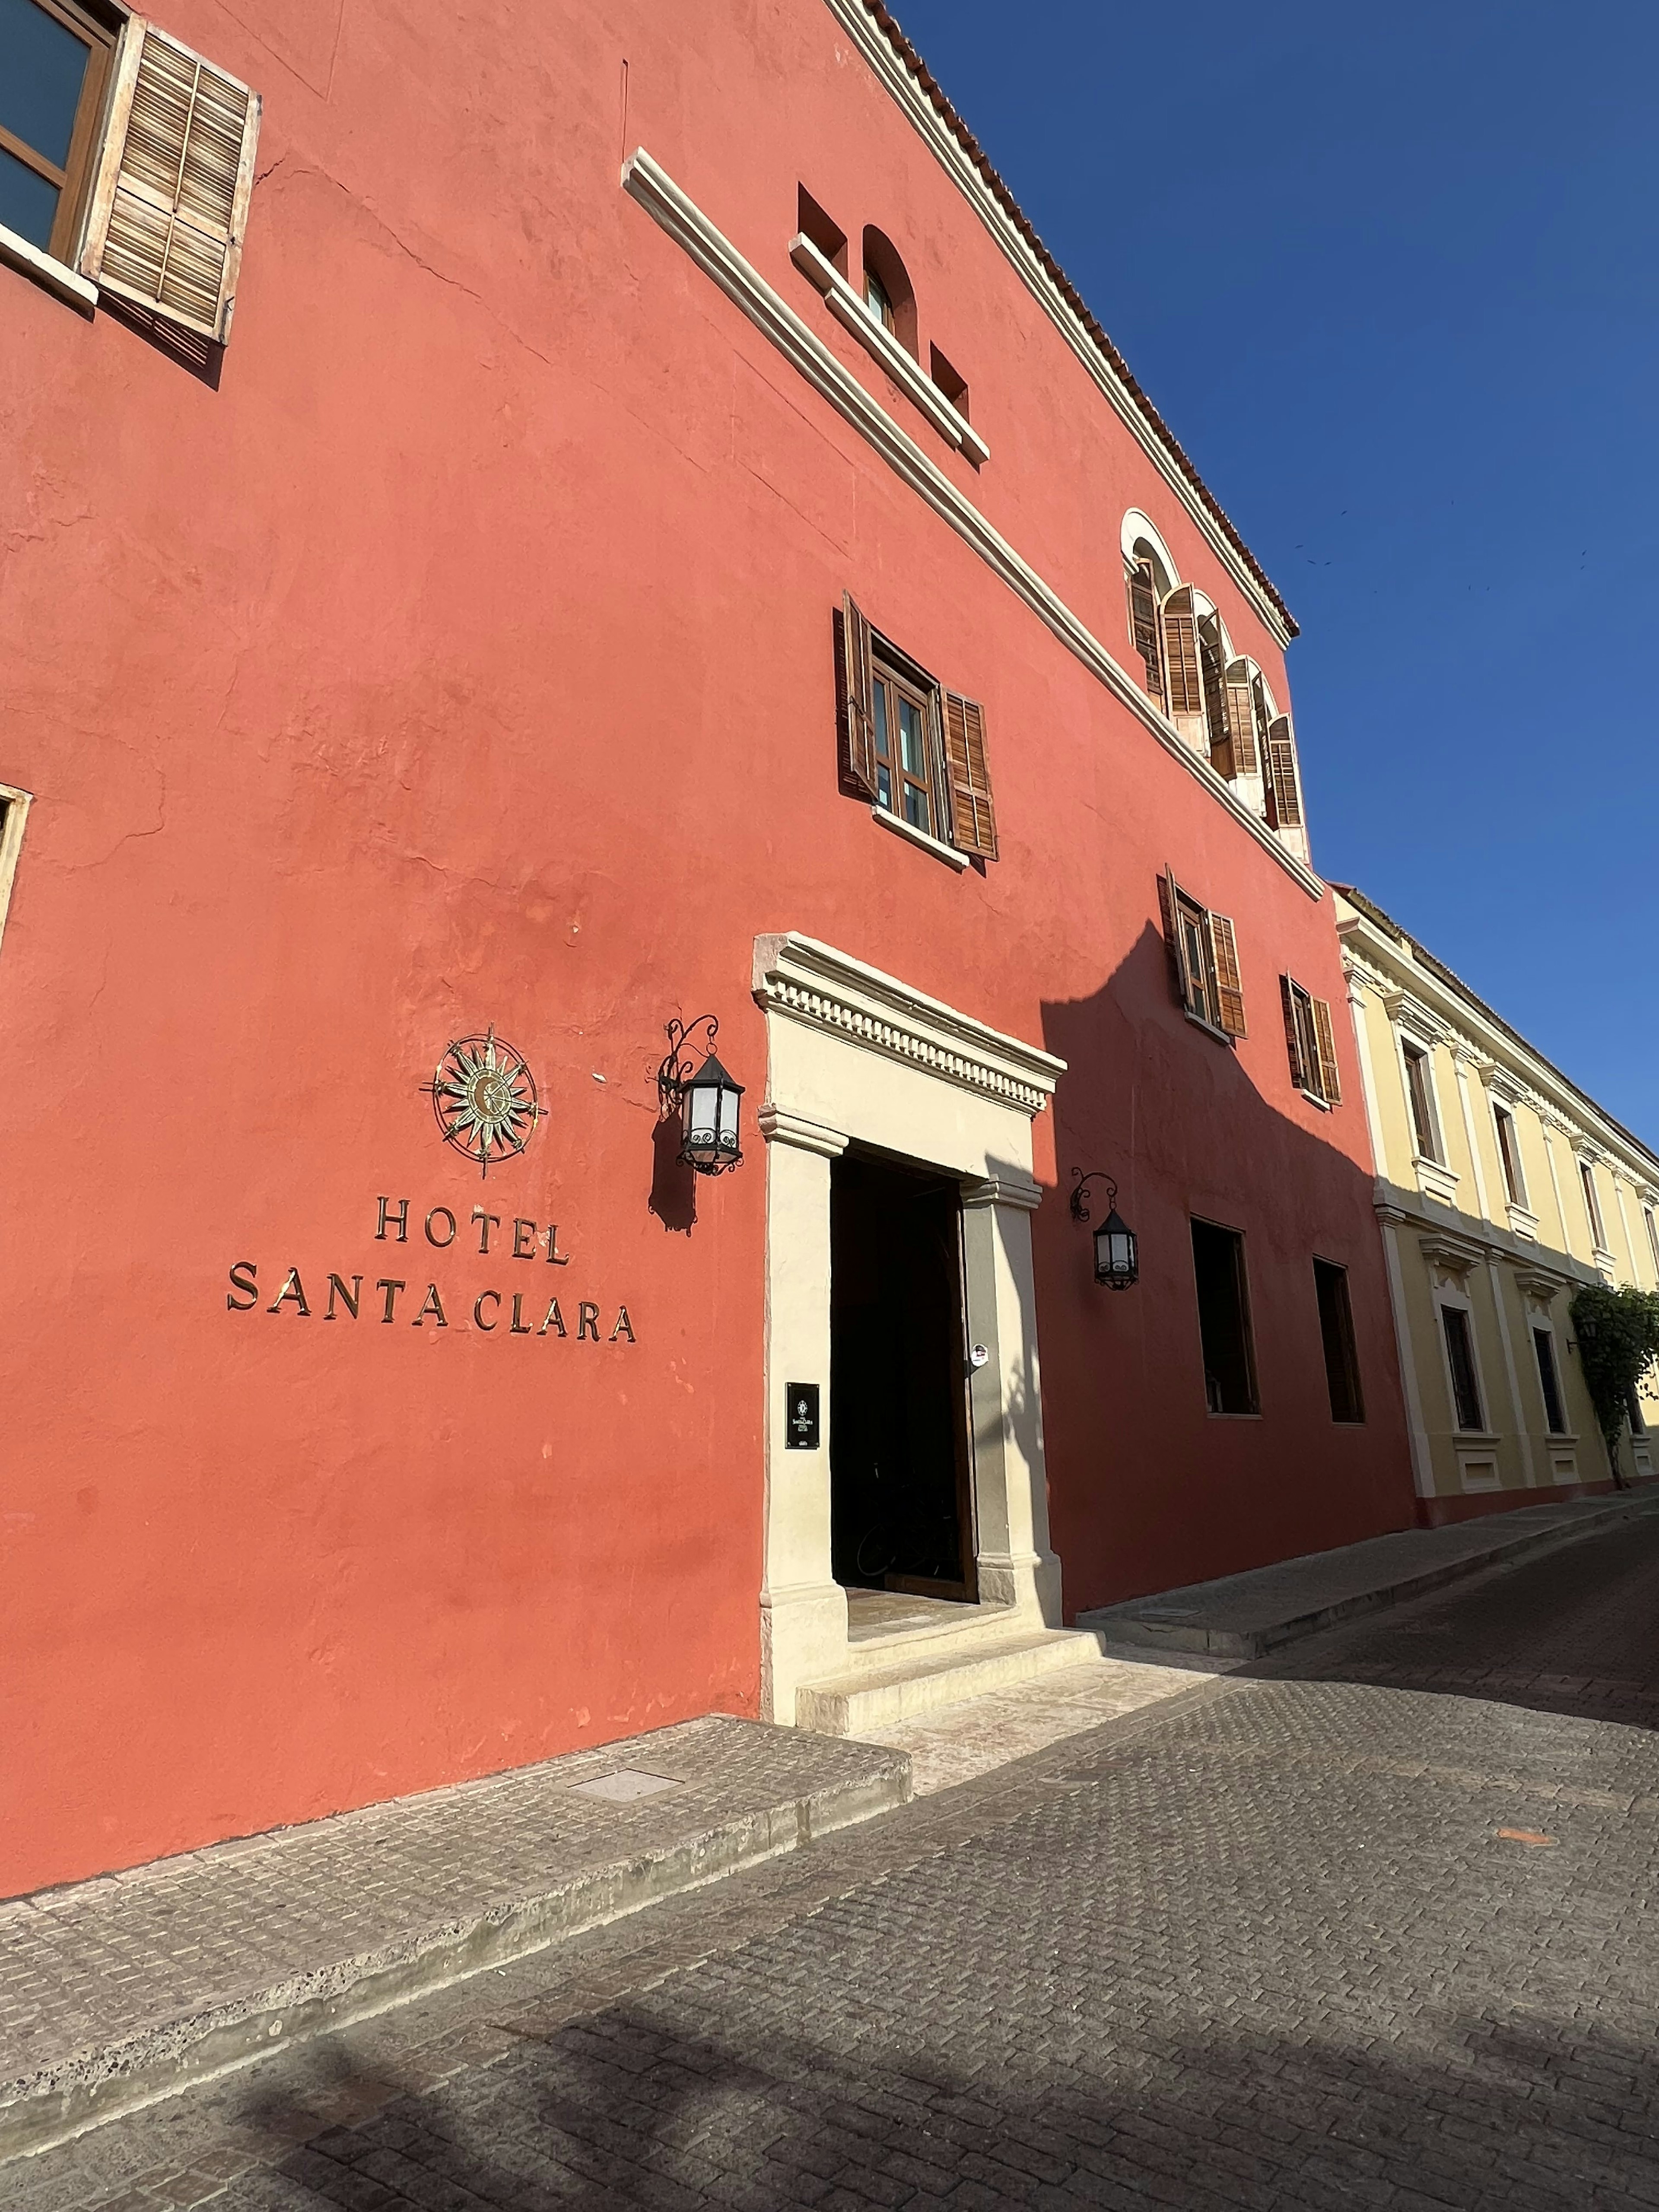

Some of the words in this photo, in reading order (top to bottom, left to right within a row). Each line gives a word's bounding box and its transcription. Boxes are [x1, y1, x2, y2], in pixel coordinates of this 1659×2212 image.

[374, 1196, 569, 1266] HOTEL
[227, 1261, 448, 1327] SANTA
[474, 1290, 636, 1343] CLARA
